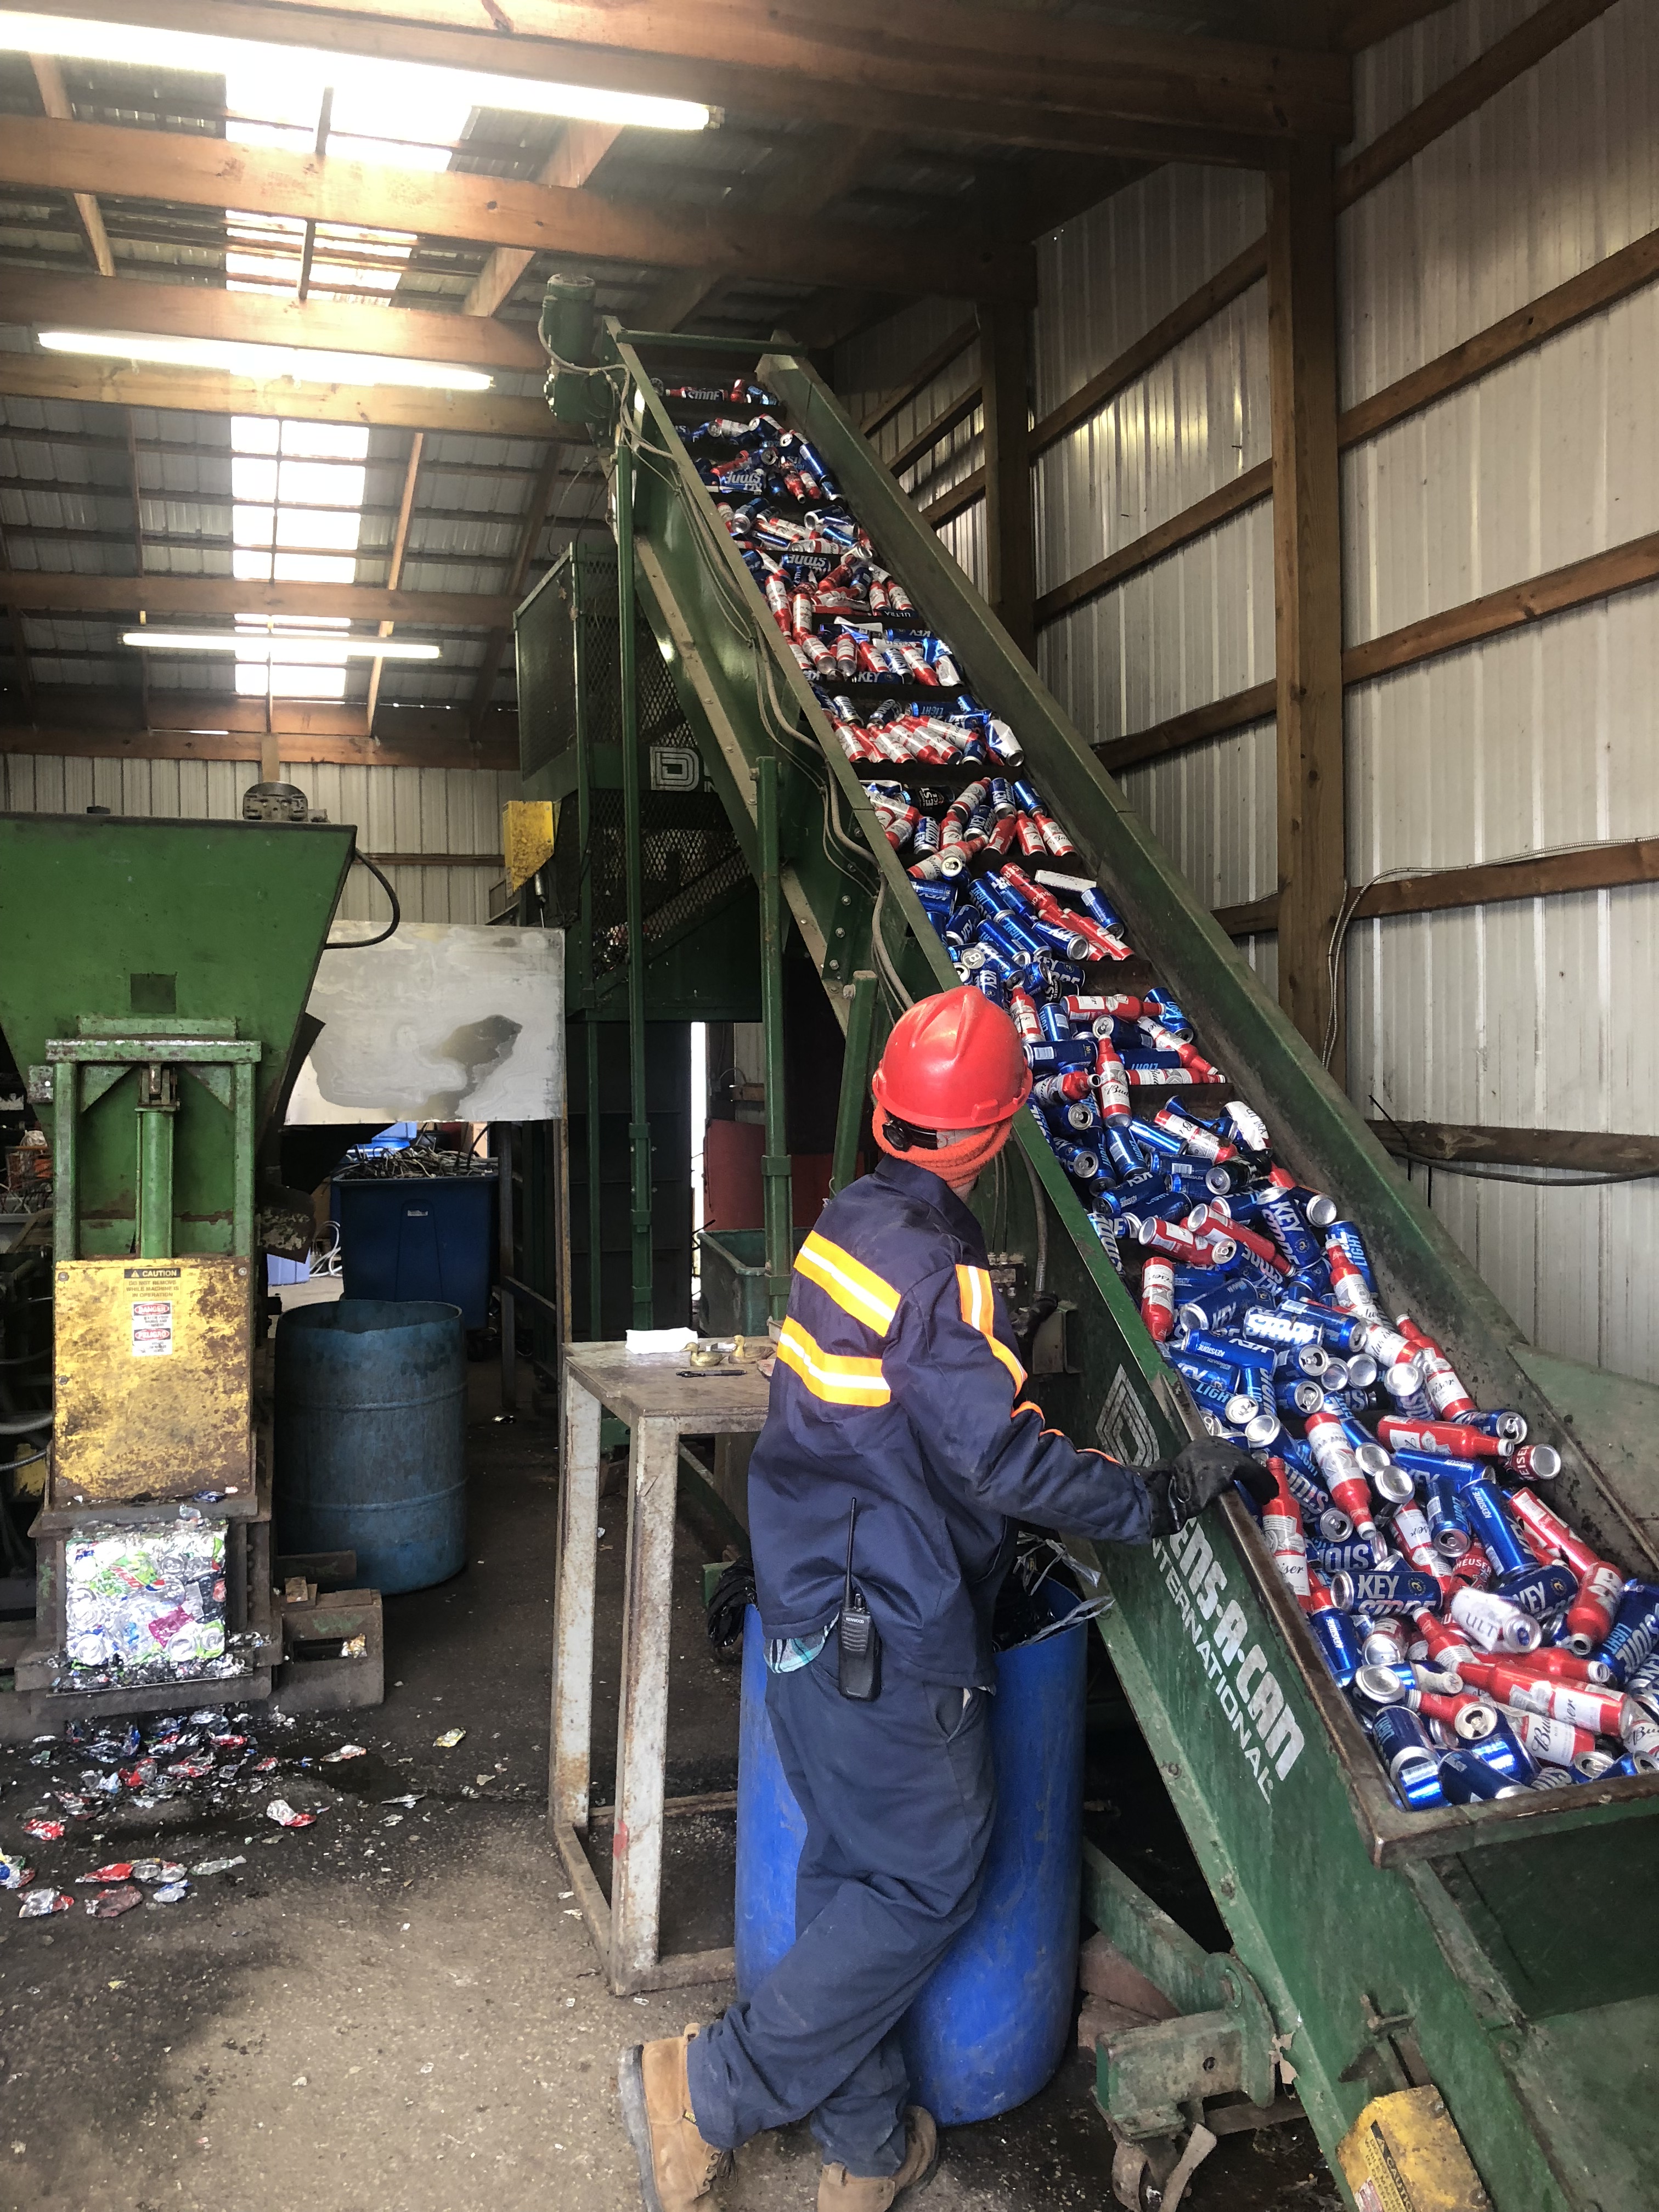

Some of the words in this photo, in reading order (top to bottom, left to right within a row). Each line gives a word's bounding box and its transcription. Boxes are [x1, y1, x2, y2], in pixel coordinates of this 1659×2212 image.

[788, 554, 826, 566] STONE
[883, 610, 911, 618] ULTRA
[857, 671, 879, 683] KEY
[922, 706, 944, 715] LIGHT
[971, 887, 988, 905] LIGHT
[1002, 923, 1024, 941] LIGHT
[1269, 1201, 1305, 1232] KEY
[1346, 1234, 1368, 1267] LIGHT
[142, 1269, 177, 1278] CAUTION
[1197, 1344, 1226, 1358] KEYSTONE
[1472, 1487, 1493, 1519] KEYSTONE
[1357, 1575, 1400, 1599] KEY
[1325, 1616, 1344, 1649] KEYSTONE
[1602, 1622, 1633, 1655] LIGHT
[1374, 1716, 1395, 1742] LIGHT
[1387, 2157, 1413, 2212] CAUTIO
